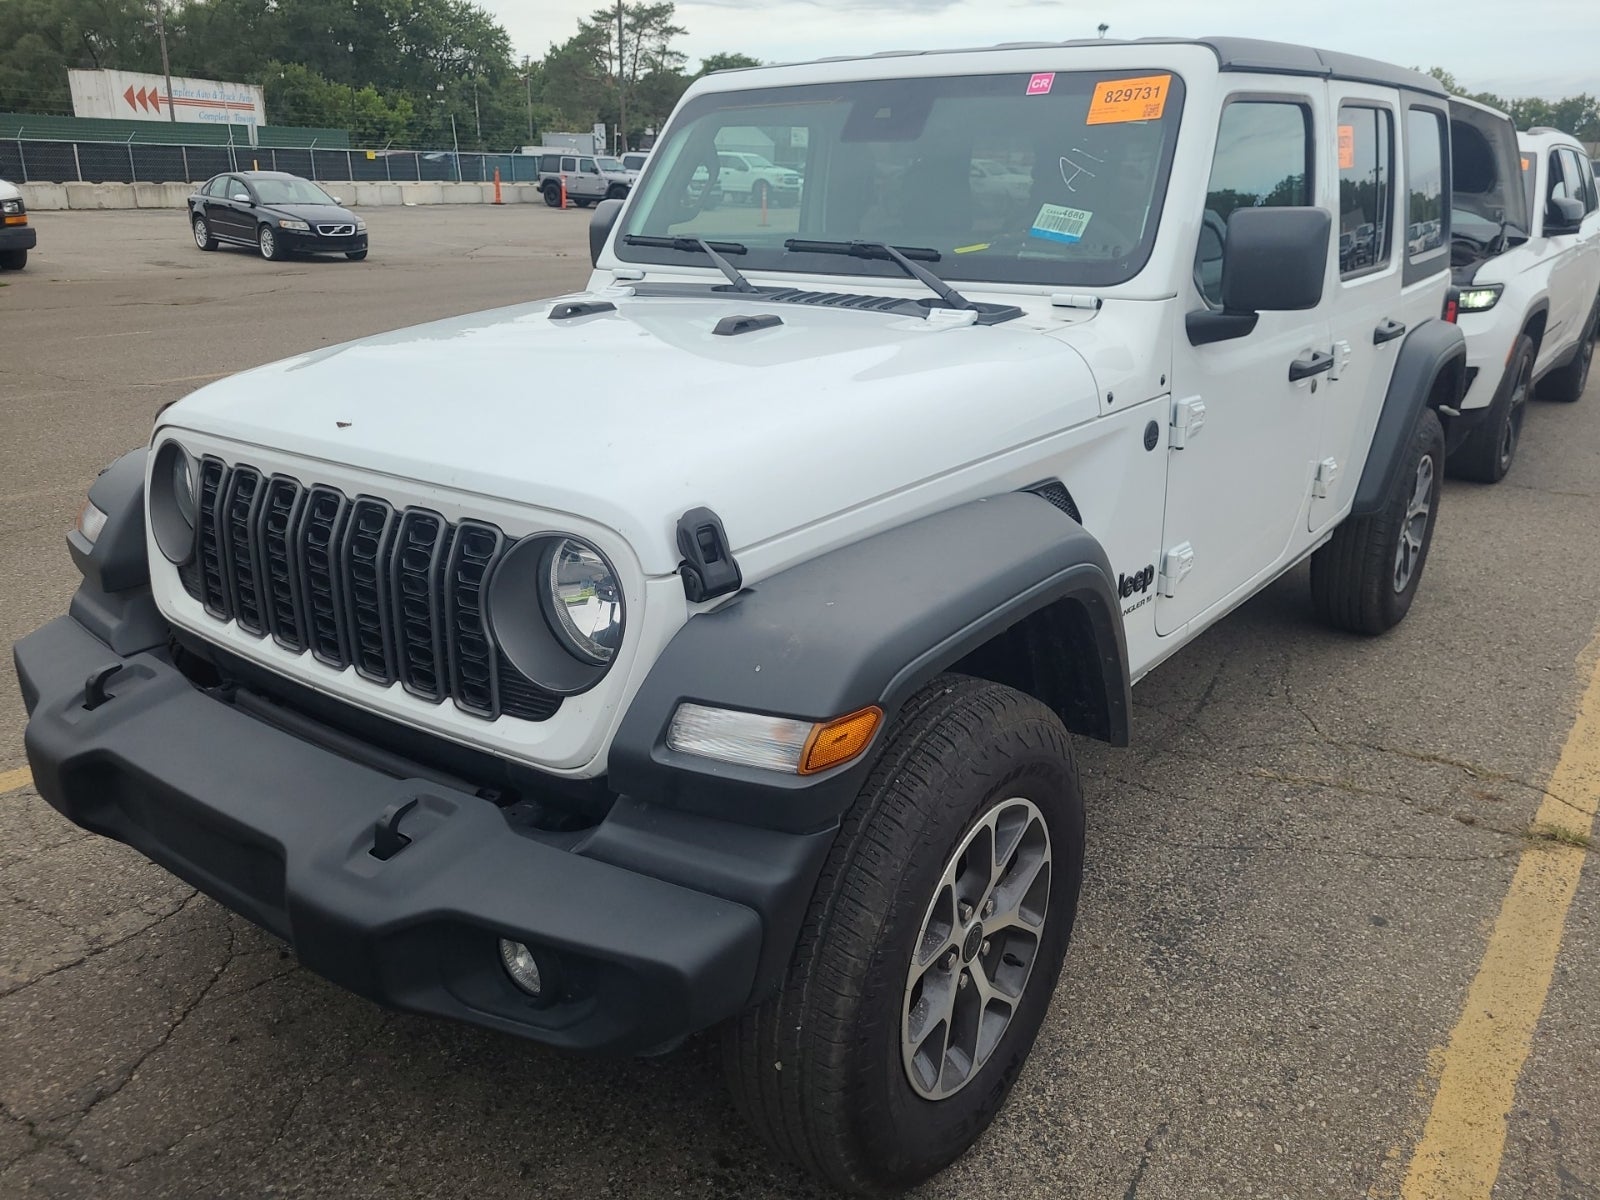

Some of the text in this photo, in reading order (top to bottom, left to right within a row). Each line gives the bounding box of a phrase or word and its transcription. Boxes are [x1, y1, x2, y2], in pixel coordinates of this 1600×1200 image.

[1031, 78, 1050, 88] CR
[162, 86, 194, 98] Cmplete
[196, 89, 211, 99] Auto
[1104, 86, 1161, 103] 829731
[198, 111, 256, 123] Complete Towing
[1118, 564, 1155, 601] Jeep
